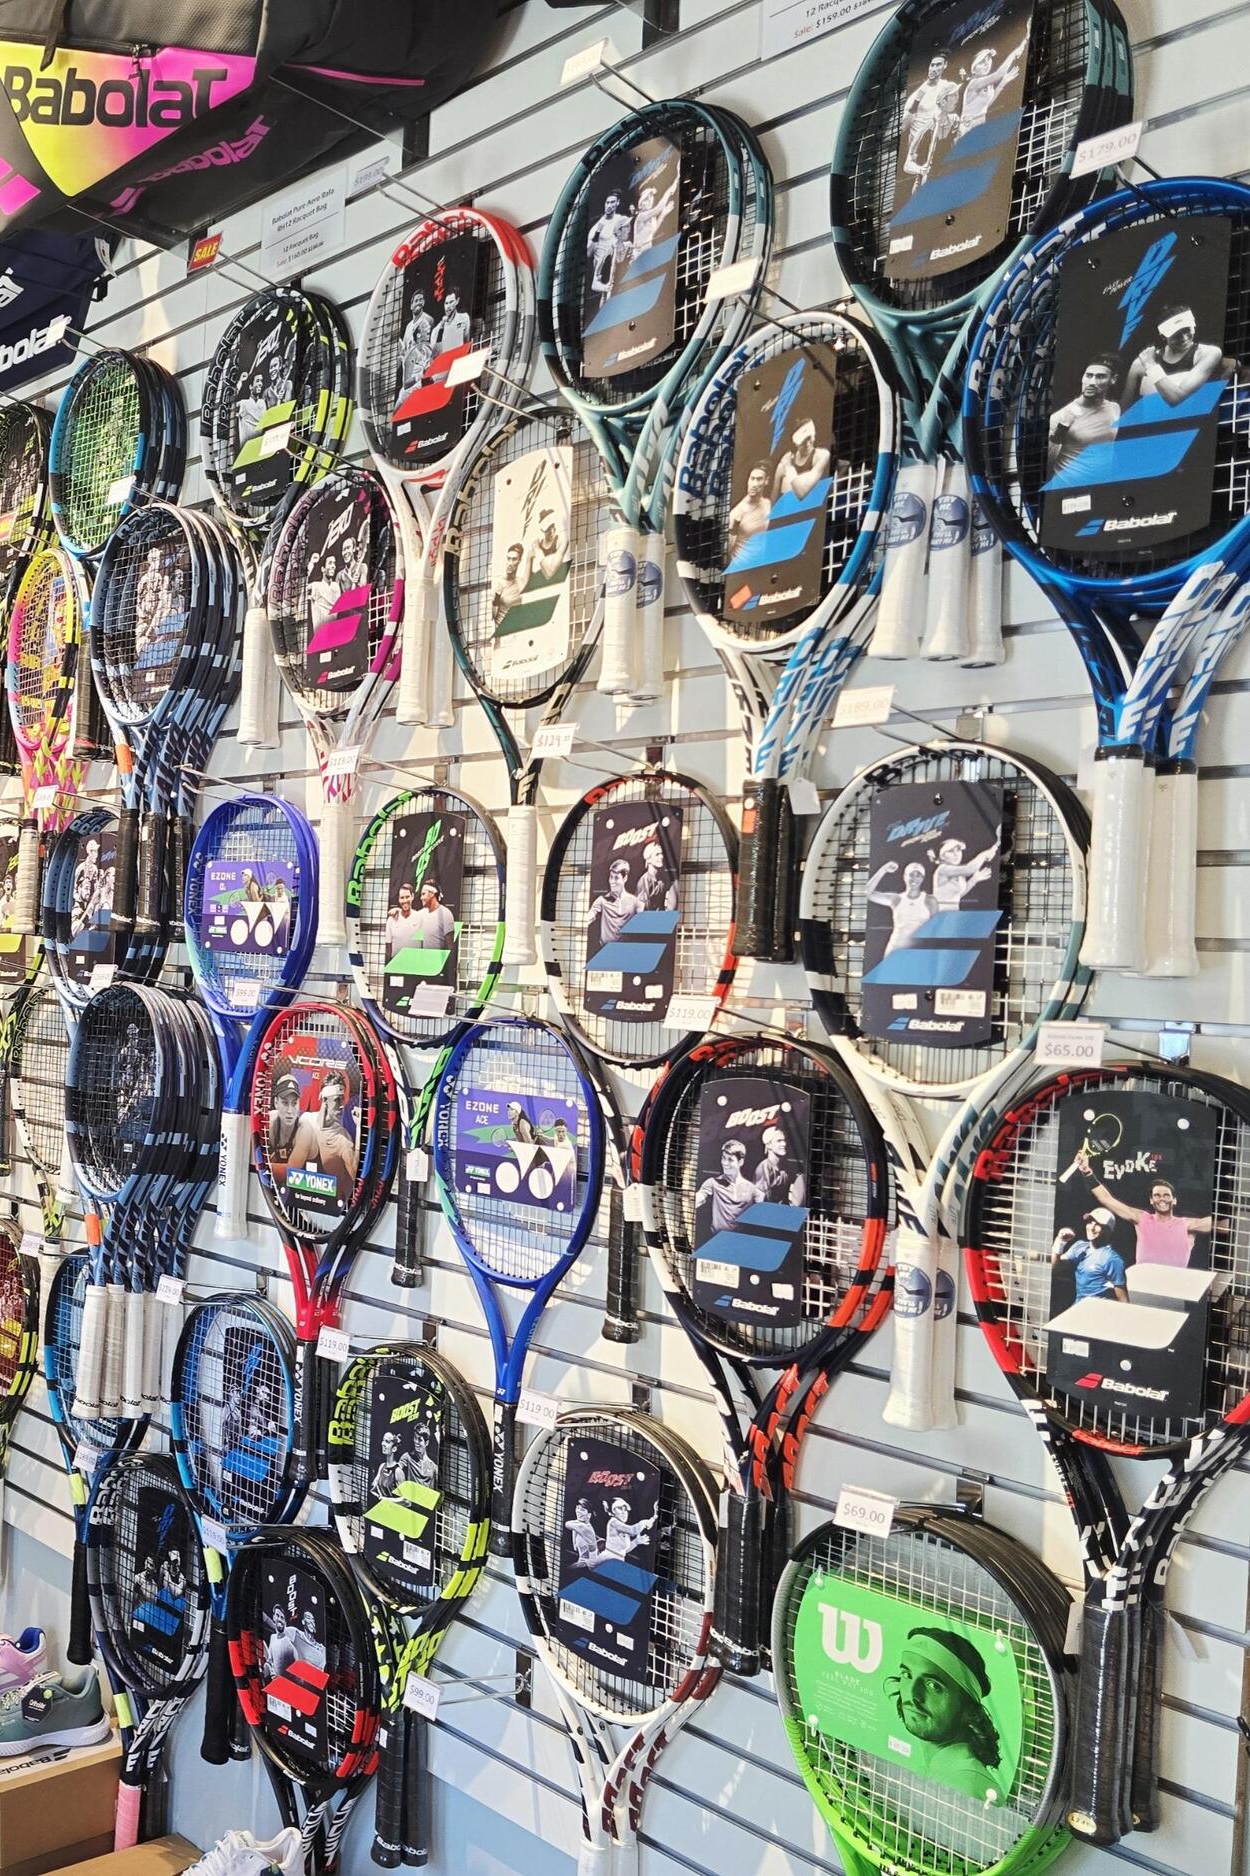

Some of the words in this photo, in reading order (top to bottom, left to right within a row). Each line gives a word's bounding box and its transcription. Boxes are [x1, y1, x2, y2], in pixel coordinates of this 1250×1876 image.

[794, 26, 813, 38] Sale:
[815, 6, 851, 28] $159.00
[1079, 132, 1137, 164] $179.00
[193, 242, 218, 262] SALE
[1103, 512, 1177, 532] Babolat
[211, 872, 237, 882] EZONE
[907, 1018, 964, 1032] Babolat
[1045, 1042, 1094, 1059] $65.00
[288, 1055, 347, 1068] VCORE
[465, 1100, 499, 1115] EZONE
[725, 1104, 781, 1128] BOOST
[438, 1104, 447, 1148] YONEX
[475, 1115, 488, 1126] ACE
[218, 1153, 227, 1187] YONEX
[305, 1176, 336, 1192] YONEX
[319, 1337, 348, 1353] $119.00
[1102, 1377, 1170, 1401] Babolat
[294, 1389, 303, 1424] YONEX
[390, 1398, 422, 1424] BOOST
[519, 1398, 555, 1419] $119.00
[493, 1450, 504, 1493] YONEX
[843, 1502, 885, 1524] $69.00
[288, 1574, 298, 1616] BOOST
[588, 1641, 628, 1666] Babolat
[408, 1686, 436, 1706] $99.00
